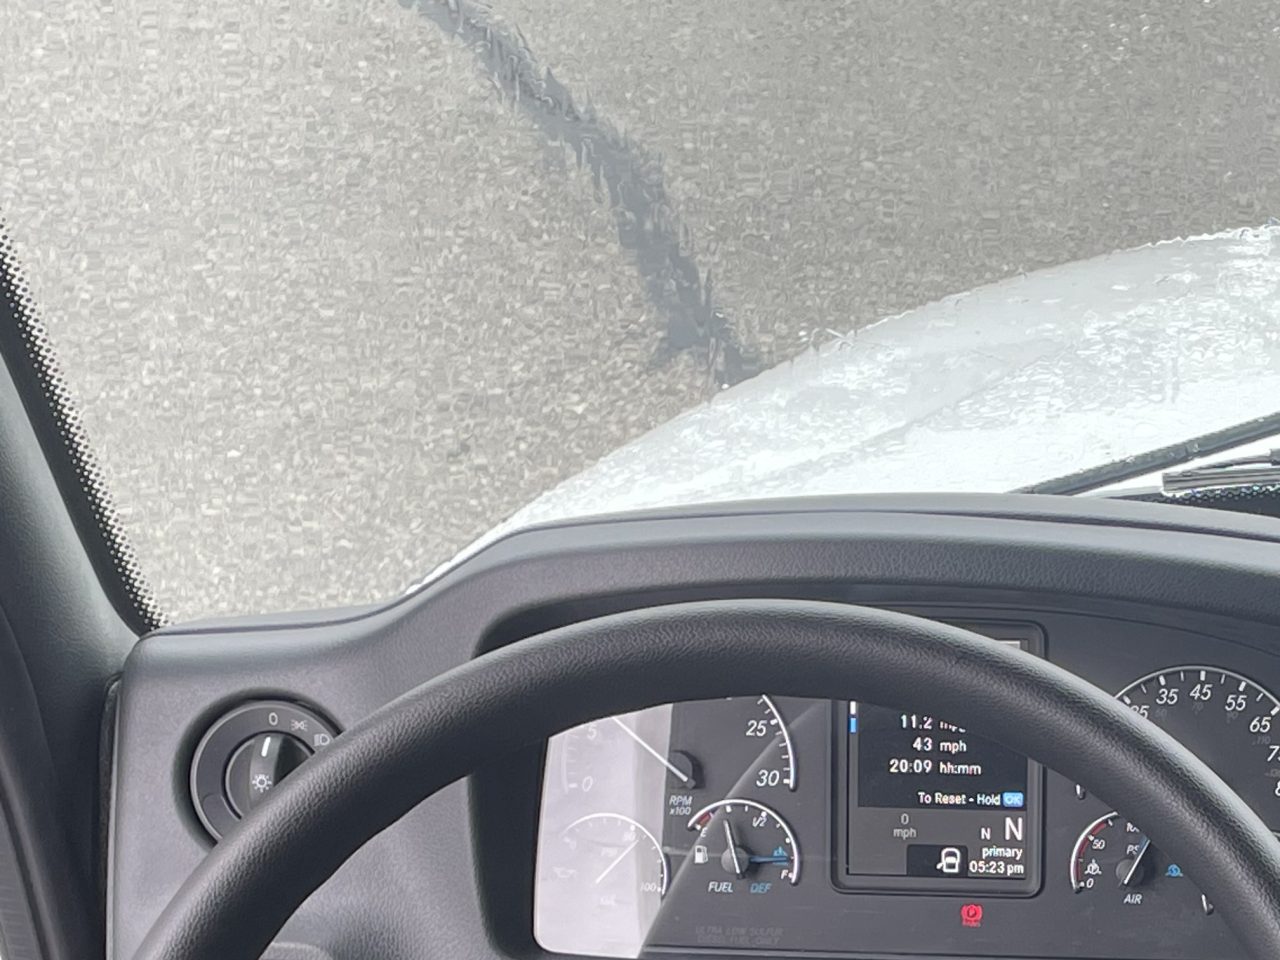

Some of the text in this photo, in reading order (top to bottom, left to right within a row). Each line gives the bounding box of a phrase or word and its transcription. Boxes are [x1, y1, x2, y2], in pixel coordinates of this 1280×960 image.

[1156, 688, 1179, 705] 35
[1189, 683, 1213, 701] 45
[1225, 694, 1247, 711] 55
[746, 720, 767, 737] 25
[901, 714, 932, 729] 11.2
[1249, 716, 1272, 733] 65
[912, 737, 967, 754] 43 mph
[889, 759, 981, 775] 20:09 hh:mm
[582, 776, 593, 792] 0
[756, 769, 780, 787] 30
[669, 795, 693, 806] RPM
[917, 791, 932, 804] To
[934, 792, 967, 804] Reset
[976, 793, 1001, 805] Hold
[900, 813, 909, 825] 0
[893, 827, 917, 839] mph
[981, 816, 1023, 841] N N
[1092, 839, 1105, 850] 50
[981, 845, 1023, 860] primary
[780, 869, 788, 879] F
[969, 860, 1024, 876] 05:23 pm
[708, 881, 734, 893] FUEL
[750, 882, 772, 893] DEF
[1123, 893, 1143, 904] AIR
